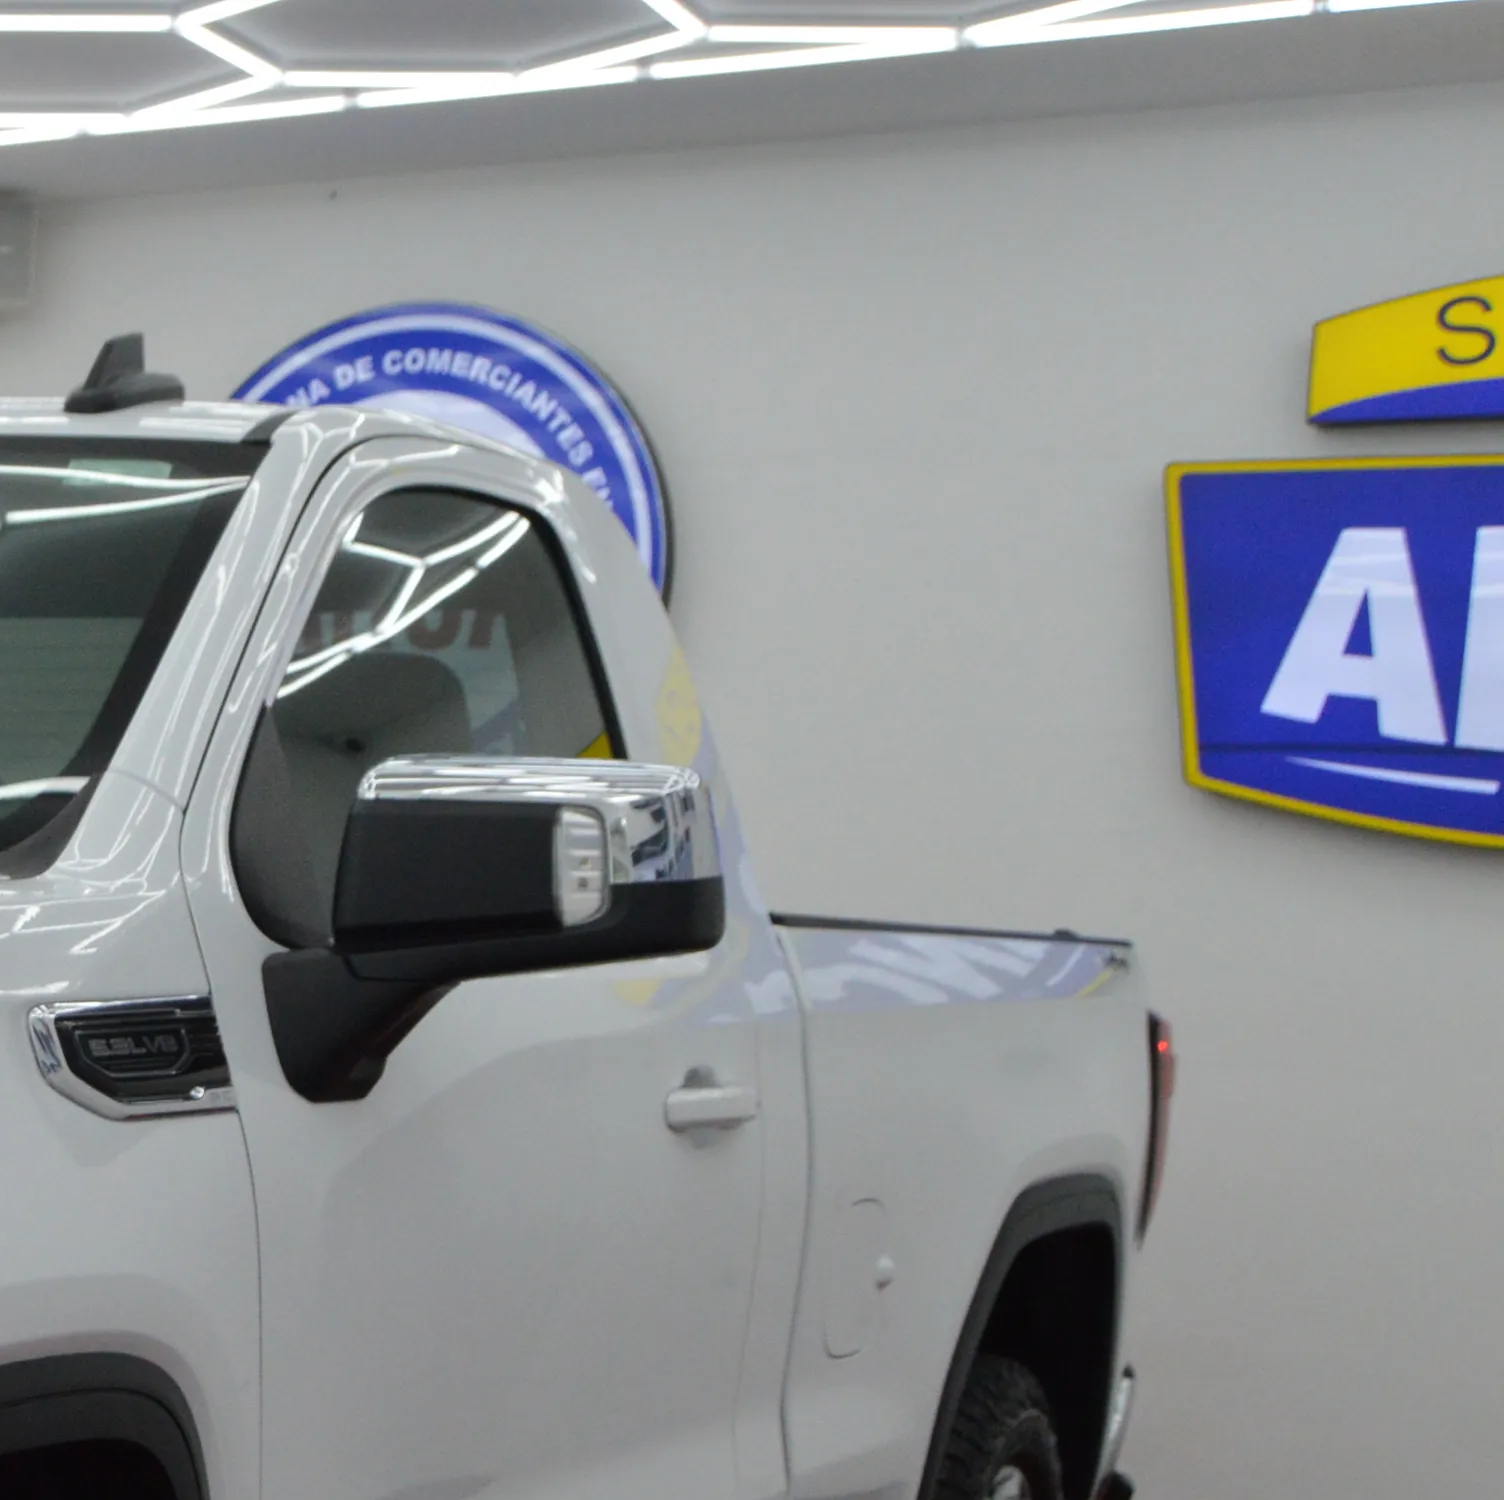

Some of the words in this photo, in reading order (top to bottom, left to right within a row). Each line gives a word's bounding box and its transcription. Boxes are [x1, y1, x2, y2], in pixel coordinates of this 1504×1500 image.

[333, 354, 376, 392] DE
[382, 347, 594, 468] COMERCIANTES
[1260, 526, 1504, 752] A
